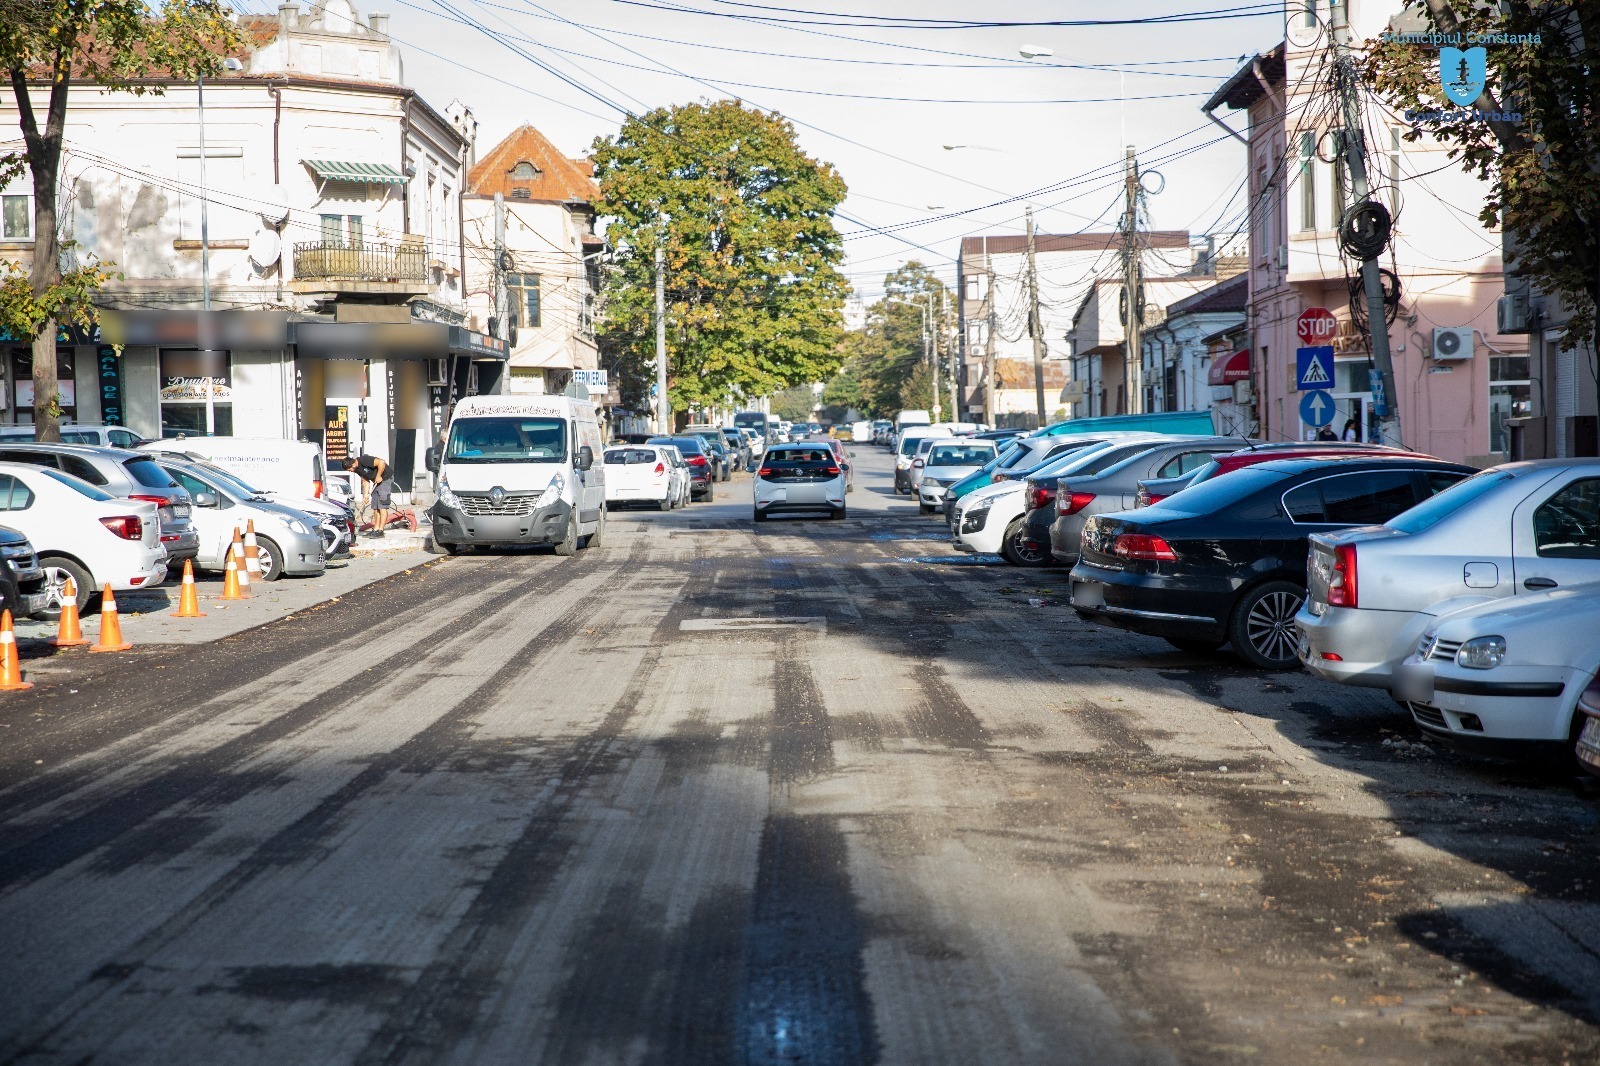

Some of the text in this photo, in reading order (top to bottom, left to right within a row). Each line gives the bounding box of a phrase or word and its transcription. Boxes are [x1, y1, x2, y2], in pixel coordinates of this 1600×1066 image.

[1298, 318, 1335, 335] STOP
[101, 350, 116, 377] SALA
[574, 371, 607, 386] FERMIERUL
[104, 386, 117, 399] DE
[433, 387, 441, 433] MANET
[329, 420, 344, 429] AUR
